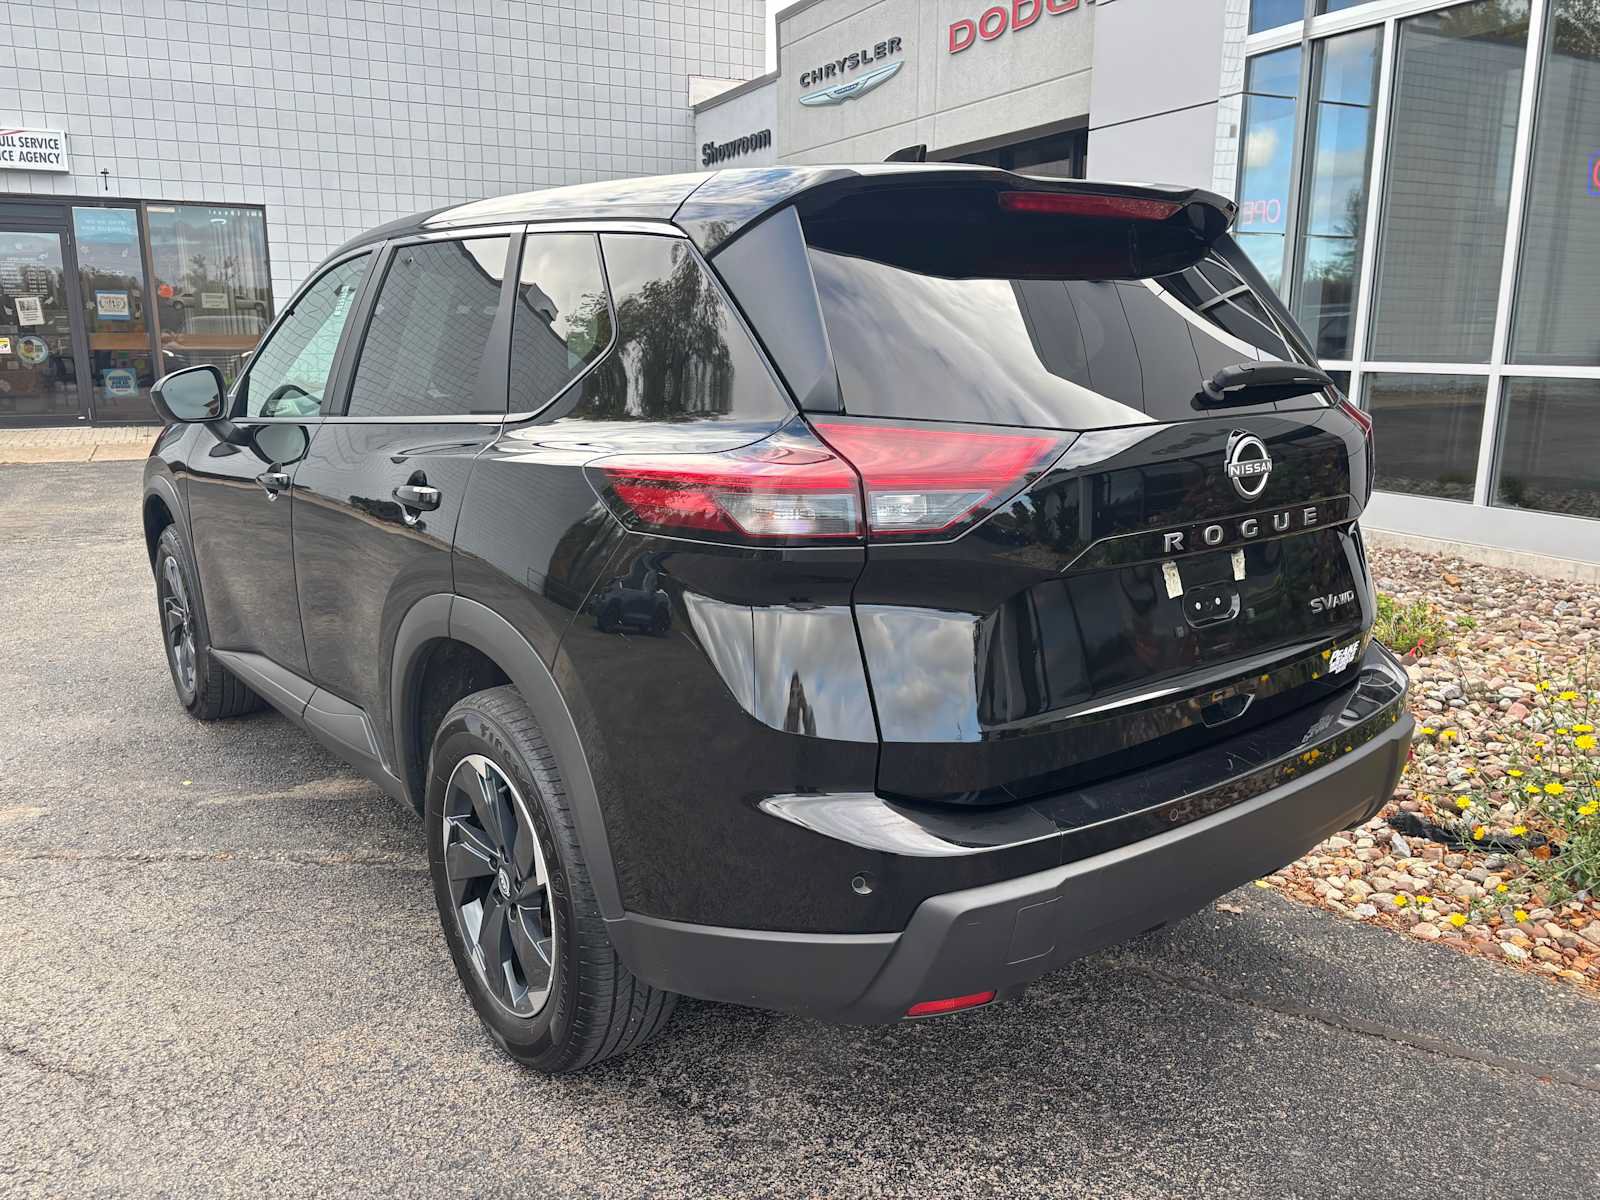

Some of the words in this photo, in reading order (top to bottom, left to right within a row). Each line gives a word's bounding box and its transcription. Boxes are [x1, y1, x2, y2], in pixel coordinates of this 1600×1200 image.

[948, 0, 1095, 55] DODG
[799, 36, 903, 88] CHRYSLER
[0, 150, 14, 162] CE
[18, 151, 60, 164] AGENCY
[18, 136, 60, 150] SERVICE
[702, 128, 772, 168] Showroom
[1230, 461, 1273, 477] NISSAN
[1163, 507, 1318, 552] ROGUE
